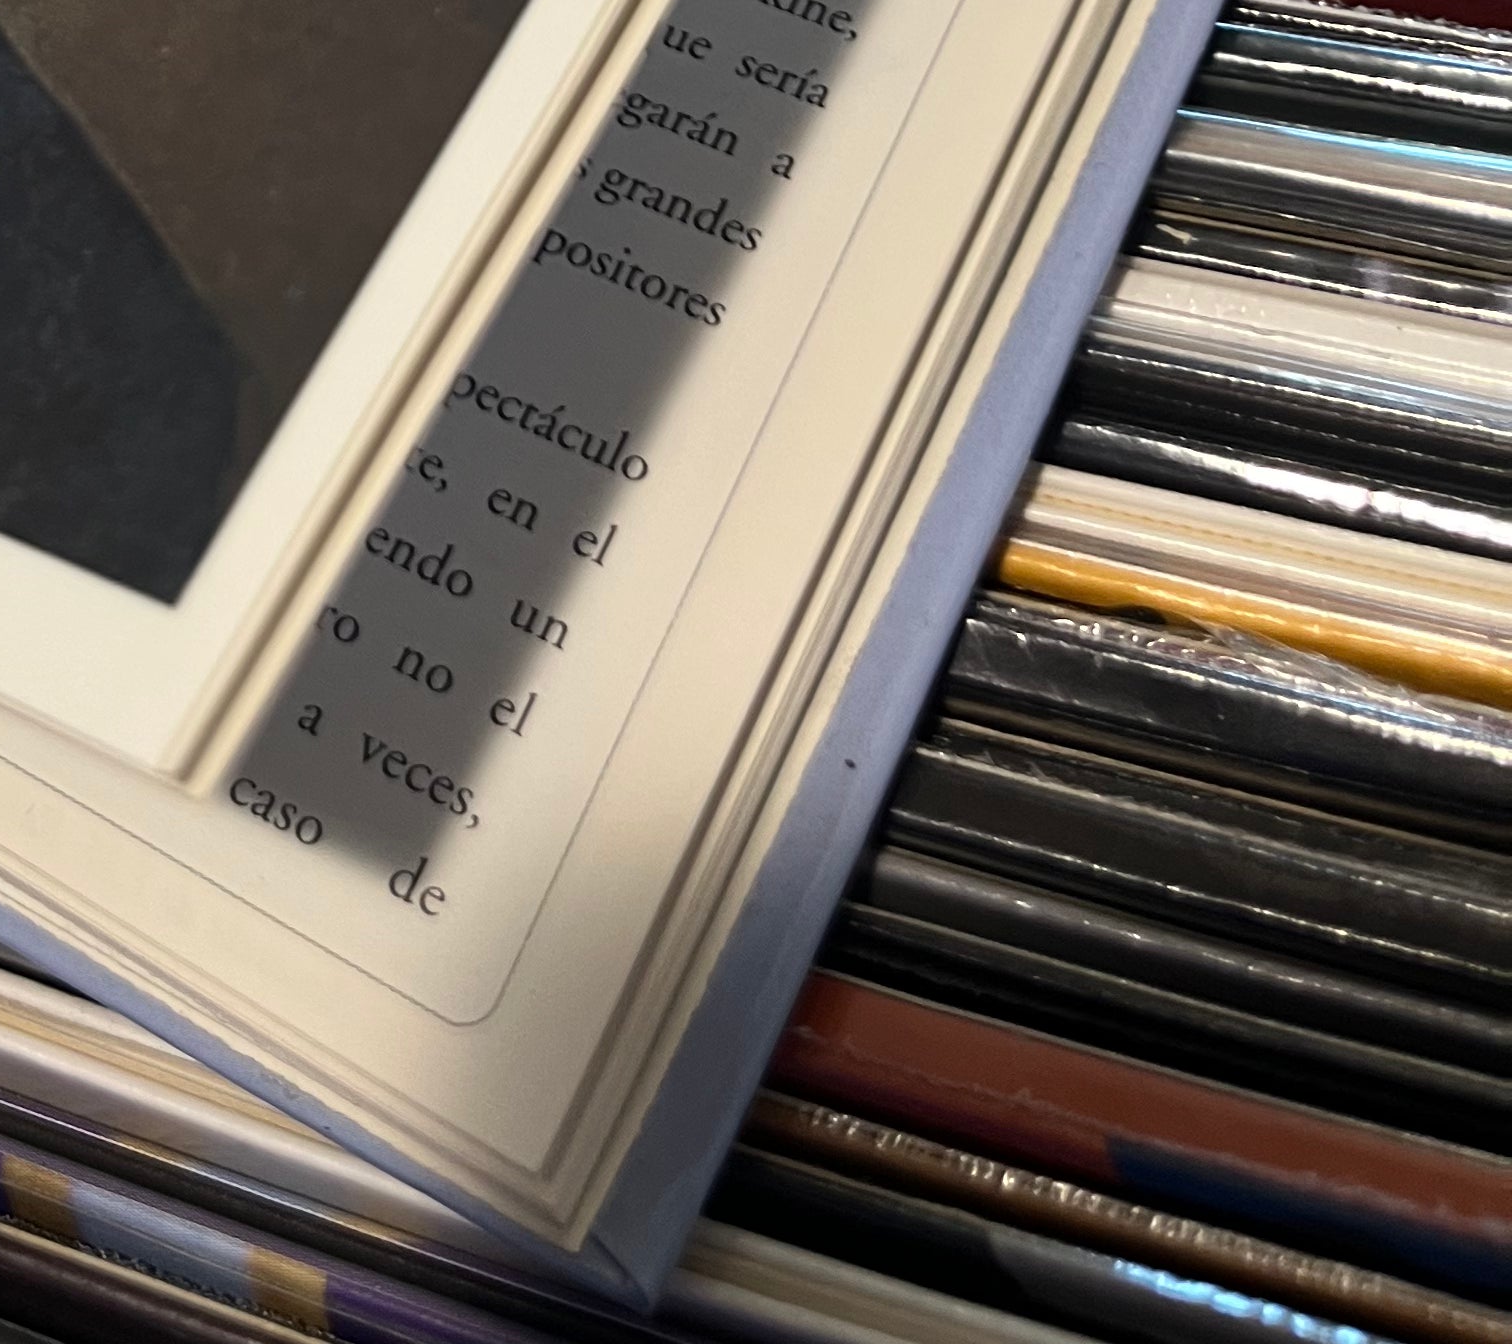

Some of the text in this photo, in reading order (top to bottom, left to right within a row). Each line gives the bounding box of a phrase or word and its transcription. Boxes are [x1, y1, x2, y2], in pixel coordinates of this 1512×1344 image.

[734, 55, 829, 109] sería
[593, 168, 763, 252] grandes
[486, 488, 618, 567] en el
[509, 598, 569, 651] un
[391, 645, 538, 737] no el
[296, 703, 480, 829] a veces,
[229, 777, 446, 917] caso de
